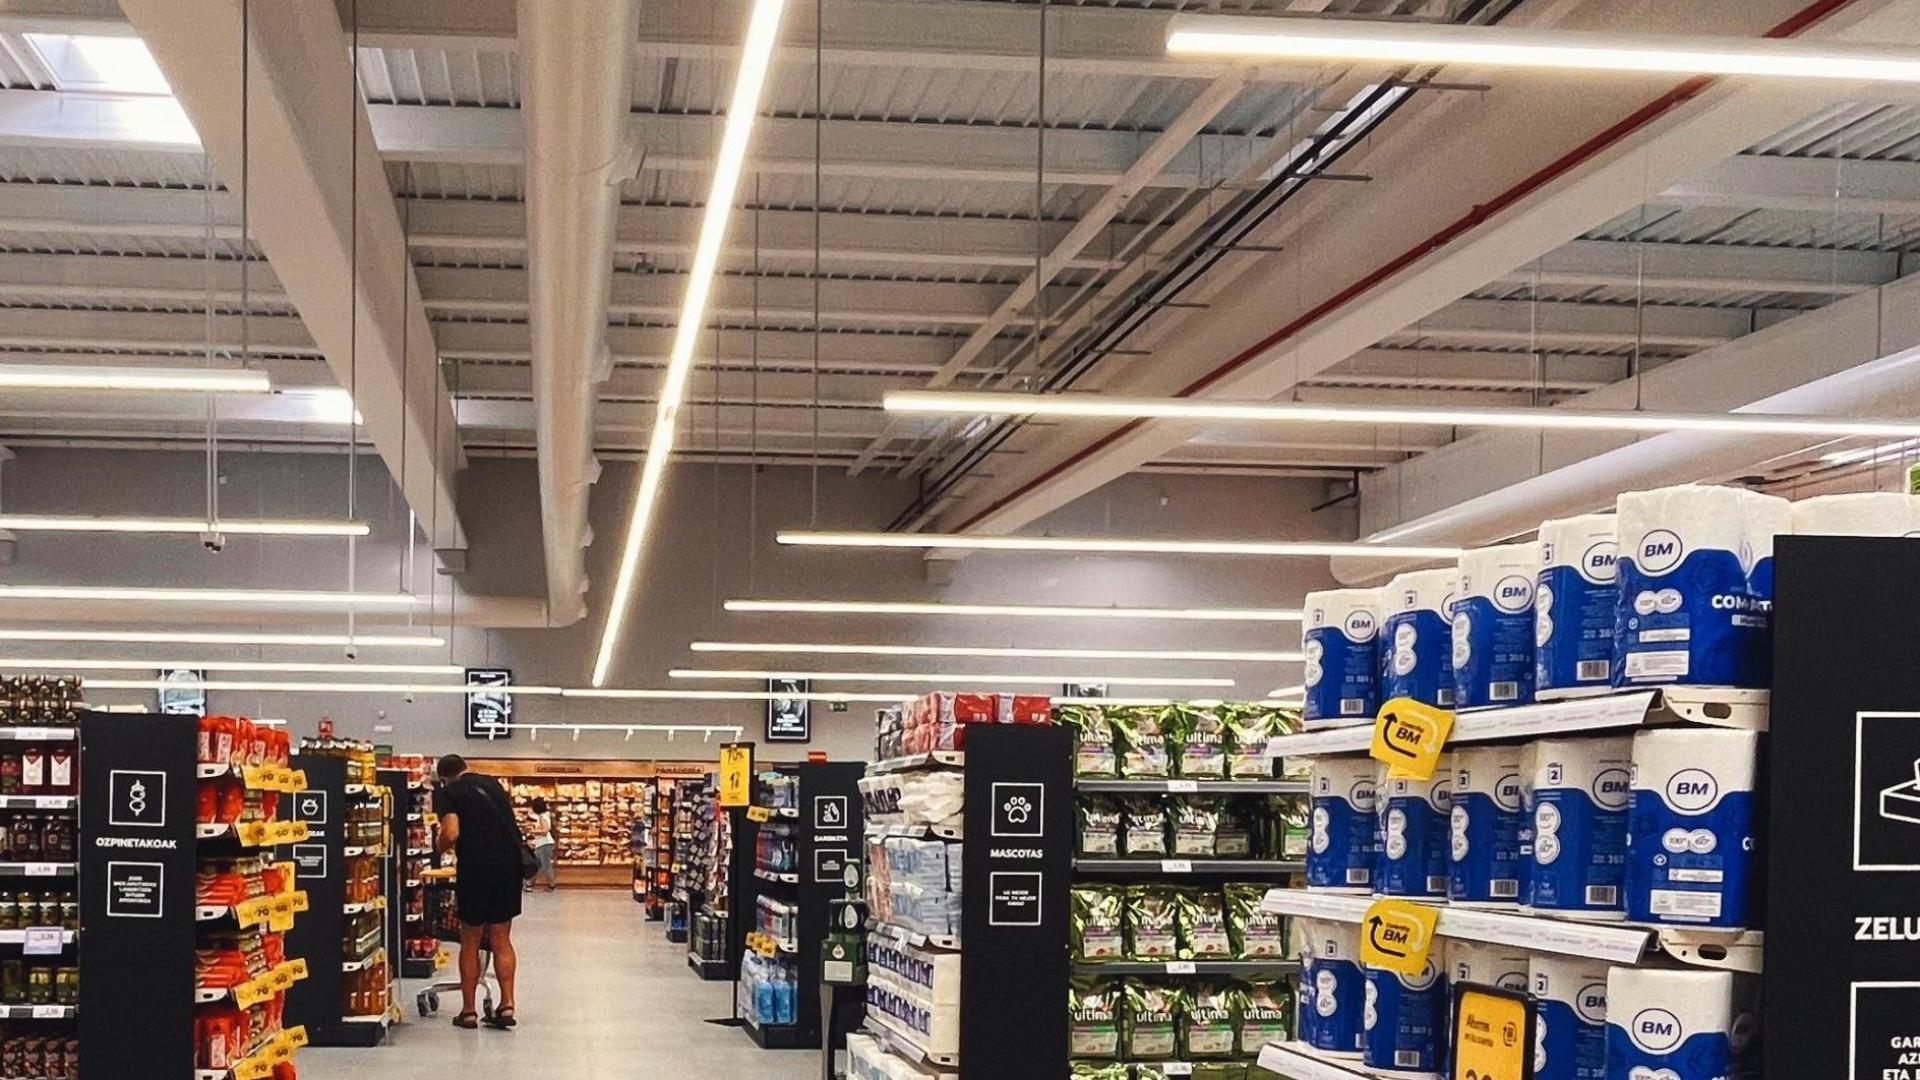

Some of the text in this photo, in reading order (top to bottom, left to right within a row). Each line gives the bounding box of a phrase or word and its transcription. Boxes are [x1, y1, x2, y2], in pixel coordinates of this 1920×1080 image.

[1645, 542, 1674, 558] BM
[1502, 587, 1527, 598] BM
[1351, 619, 1371, 629] BM
[1186, 731, 1223, 744] ultima
[1395, 728, 1422, 744] BM
[1551, 770, 1558, 779] 2
[1676, 782, 1709, 795] BM
[96, 837, 177, 849] OZPINETAKOAK
[990, 849, 1043, 858] MASCOTAS
[1855, 917, 1920, 940] ZELU
[1383, 929, 1408, 944] BM
[1074, 1010, 1113, 1022] ultima
[1136, 1010, 1172, 1023] ultima
[1191, 1008, 1229, 1020] ultima
[1243, 1008, 1281, 1020] ultima
[1641, 1021, 1672, 1036] BM
[1883, 1068, 1910, 1080] ETA
